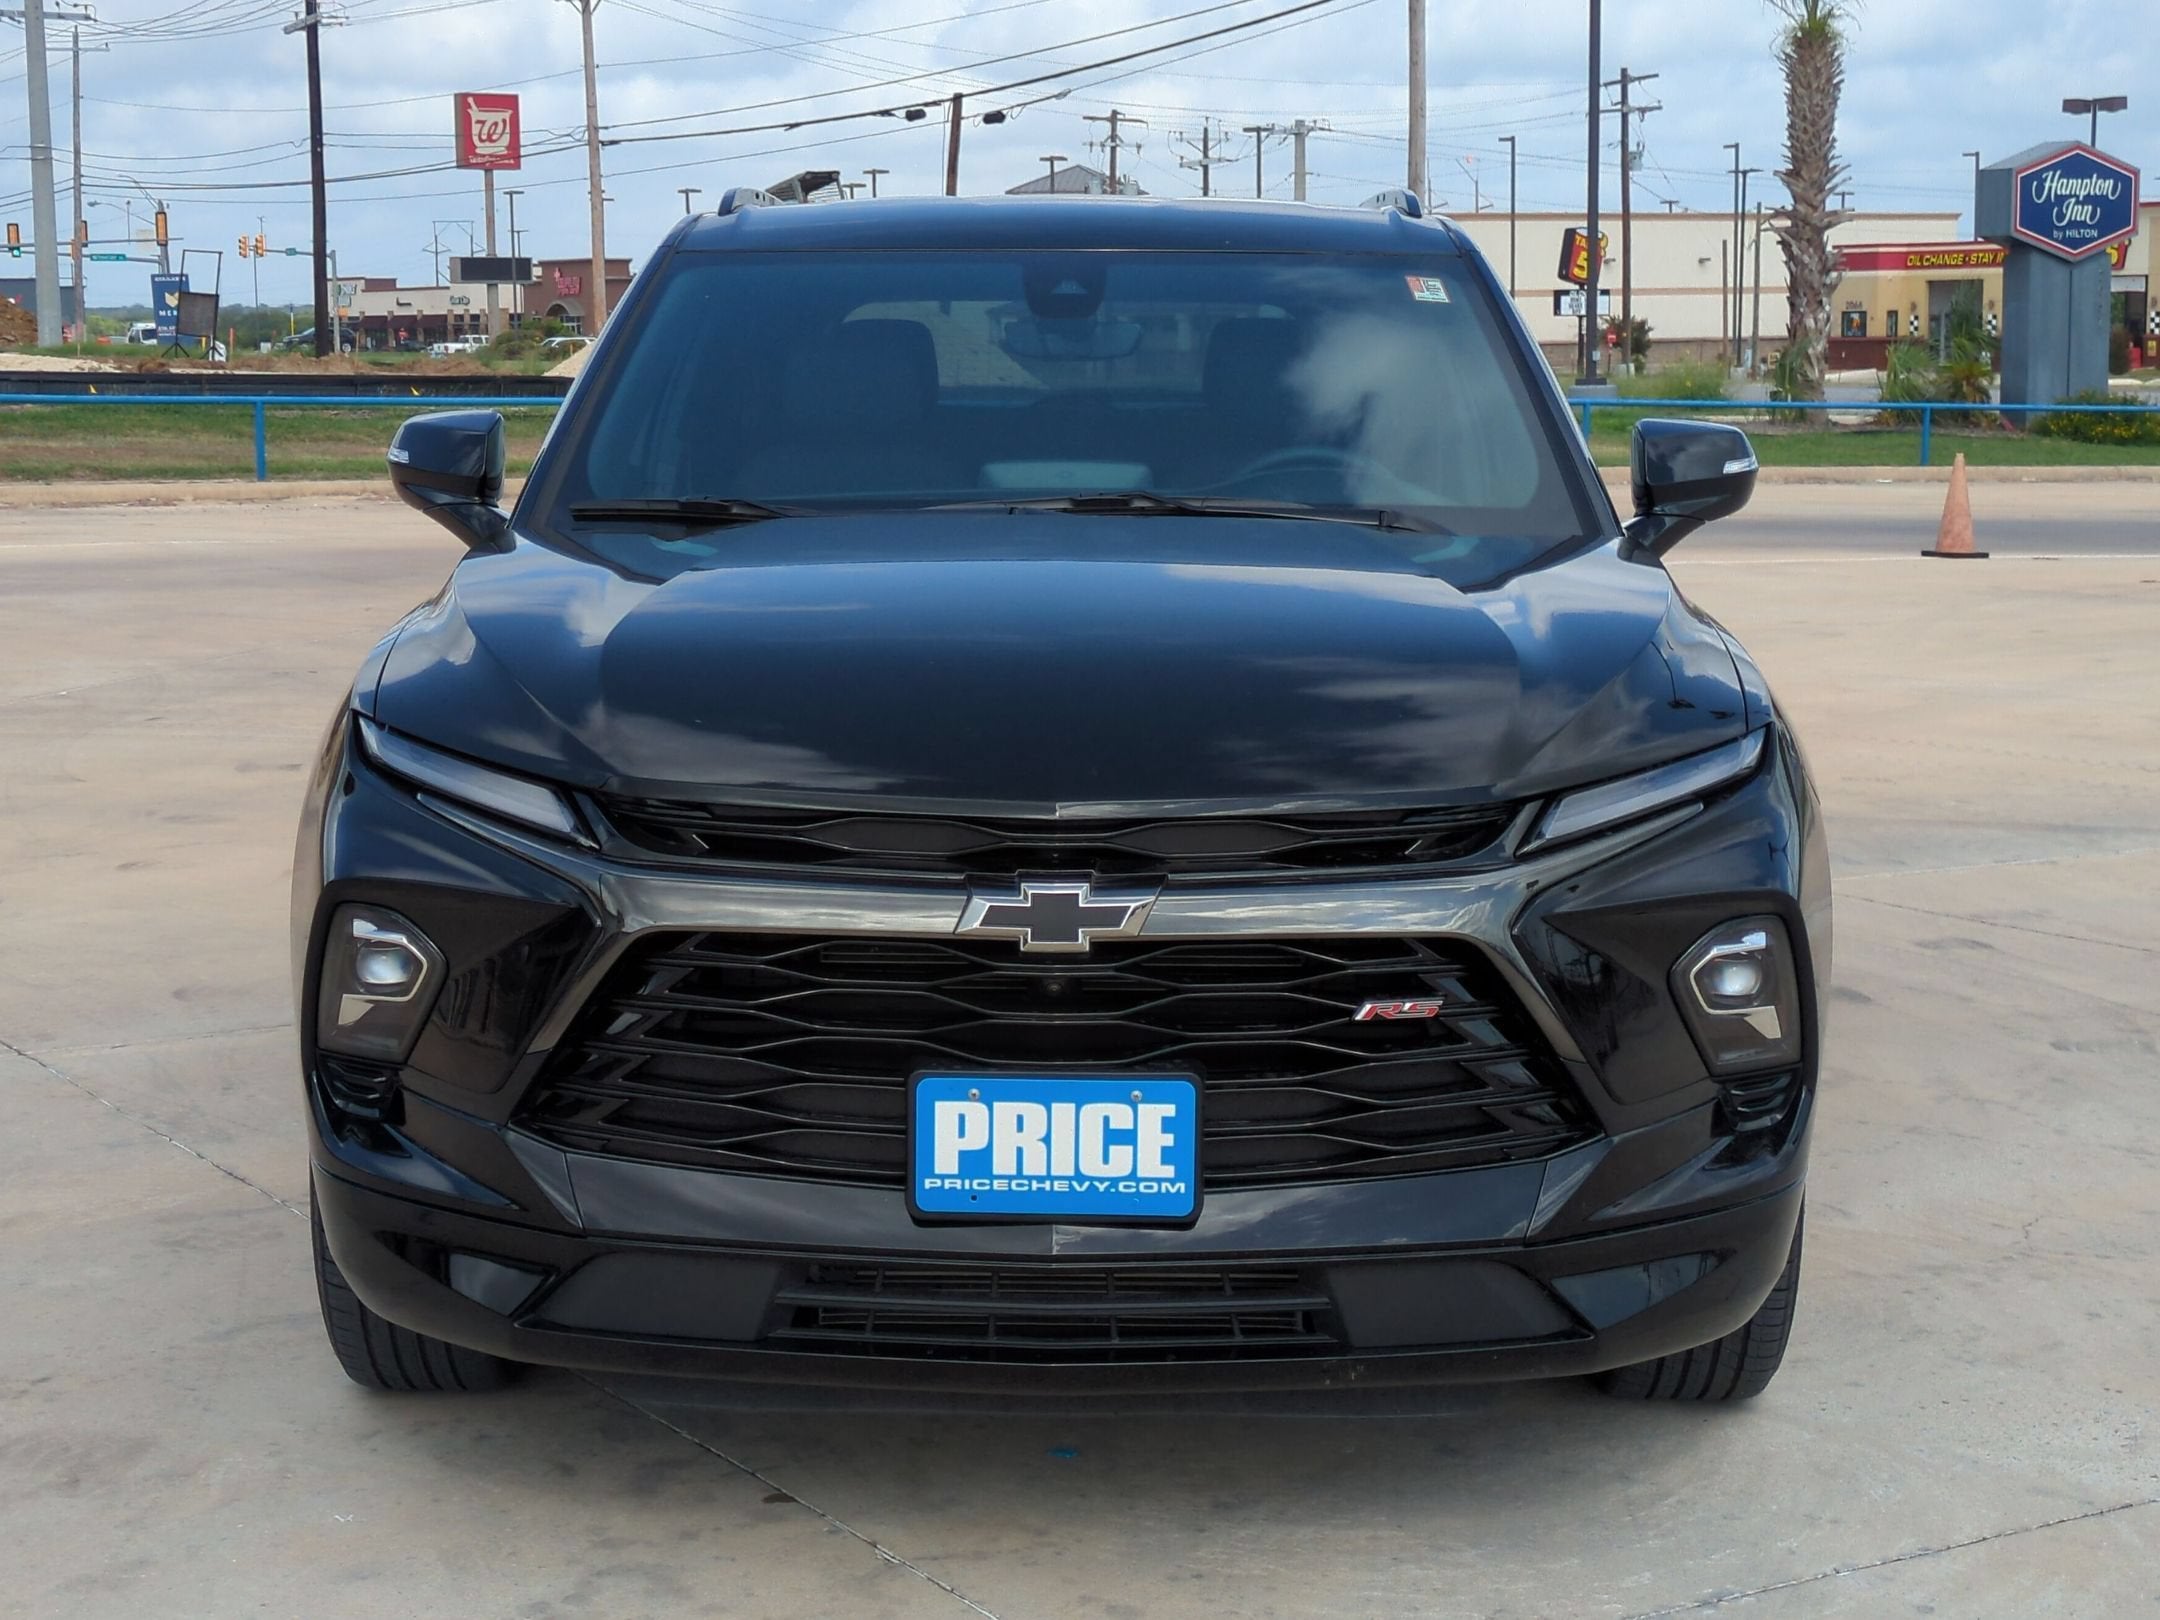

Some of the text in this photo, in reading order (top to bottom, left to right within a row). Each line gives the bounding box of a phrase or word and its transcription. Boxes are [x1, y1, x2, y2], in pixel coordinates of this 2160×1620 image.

[2032, 170, 2121, 204] Hampton
[2053, 199, 2100, 226] Inn
[2053, 229, 2098, 240] by HILTON
[1907, 255, 1921, 266] OIL
[1923, 253, 1964, 266] CHANGE
[1970, 252, 1994, 264] STAY
[1354, 1000, 1444, 1021] RS
[934, 1100, 1176, 1179] PRICE
[924, 1179, 1185, 1194] PRICECHEVY.COM
